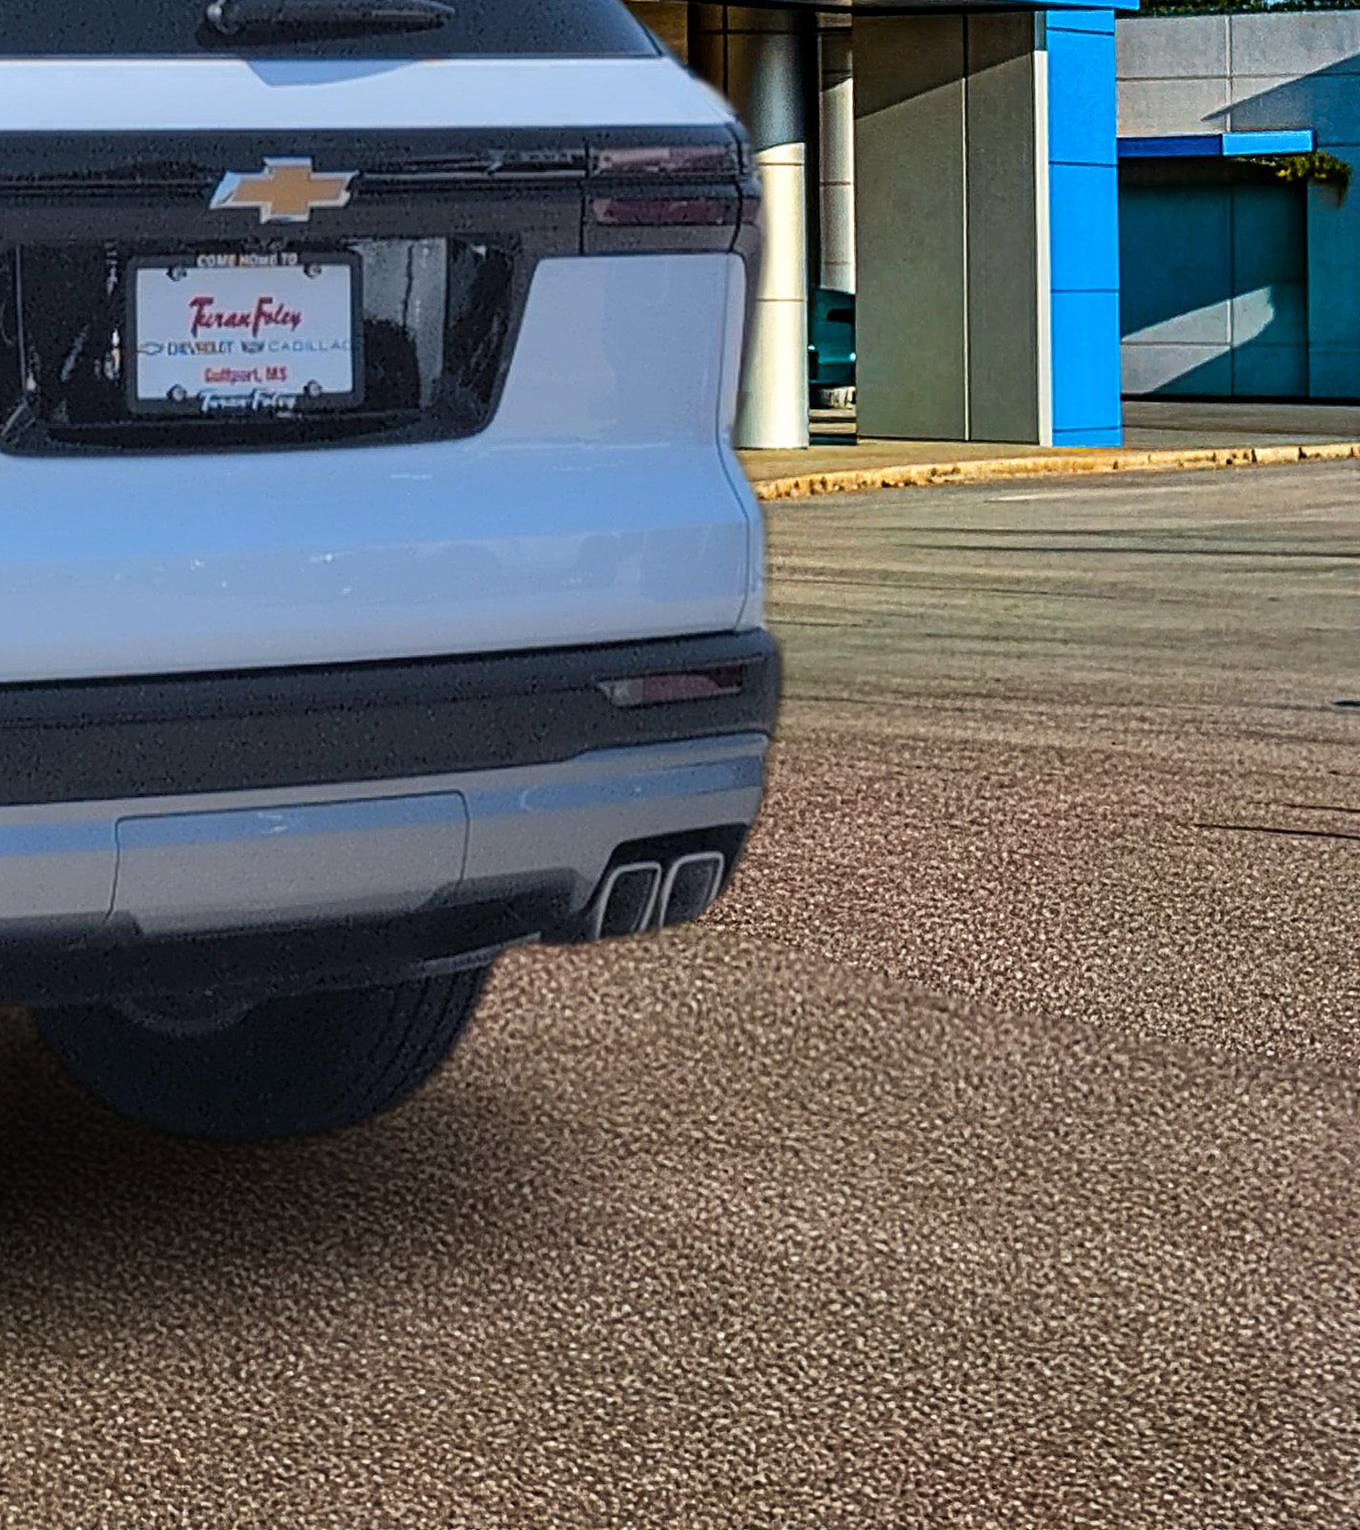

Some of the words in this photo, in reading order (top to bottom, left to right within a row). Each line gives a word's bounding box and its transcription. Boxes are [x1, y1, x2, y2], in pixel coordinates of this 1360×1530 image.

[197, 254, 236, 267] COME
[239, 254, 278, 266] HOME
[281, 252, 298, 265] TO
[265, 366, 288, 382] MS
